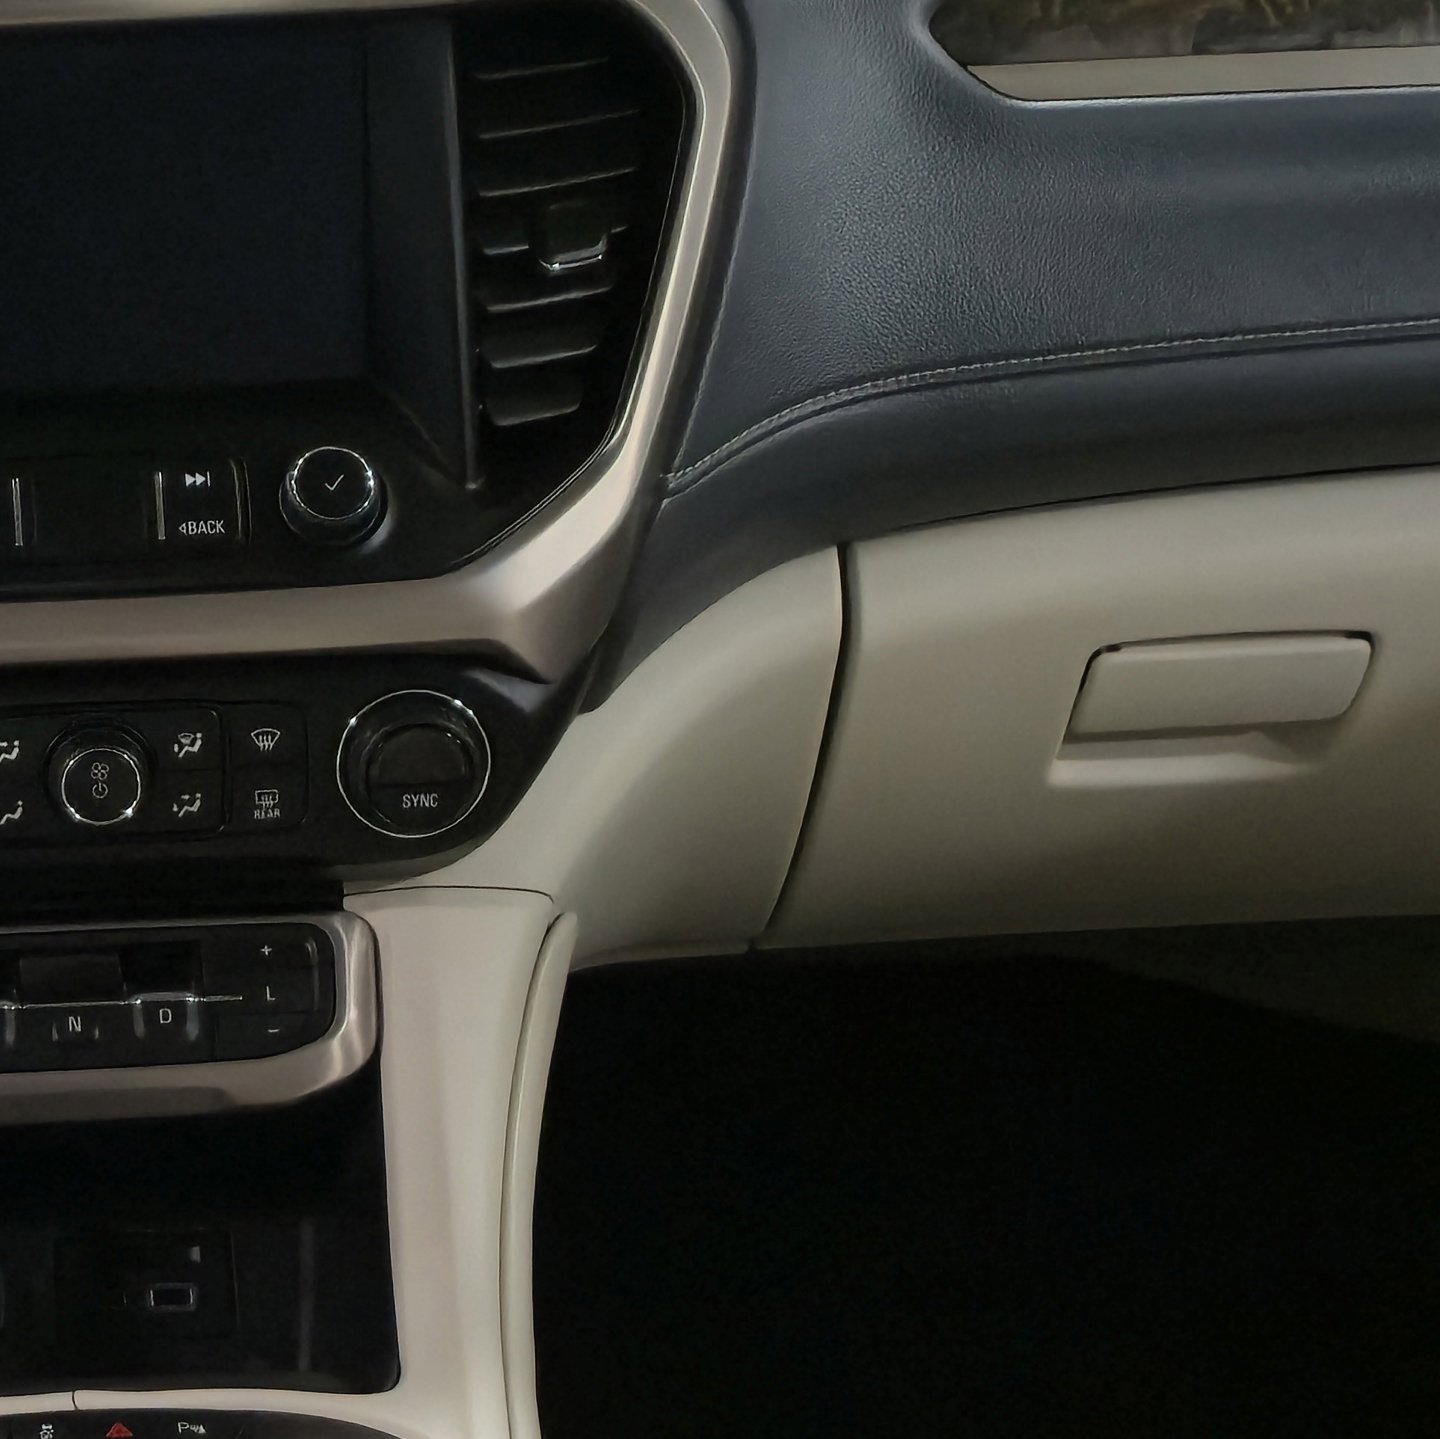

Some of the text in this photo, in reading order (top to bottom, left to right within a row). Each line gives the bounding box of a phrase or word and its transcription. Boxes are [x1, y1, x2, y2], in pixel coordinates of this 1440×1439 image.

[188, 519, 226, 535] BACK
[402, 792, 440, 809] SYNC
[254, 808, 281, 820] REAR
[266, 985, 276, 1001] L
[159, 1007, 172, 1024] D
[68, 1016, 82, 1032] N
